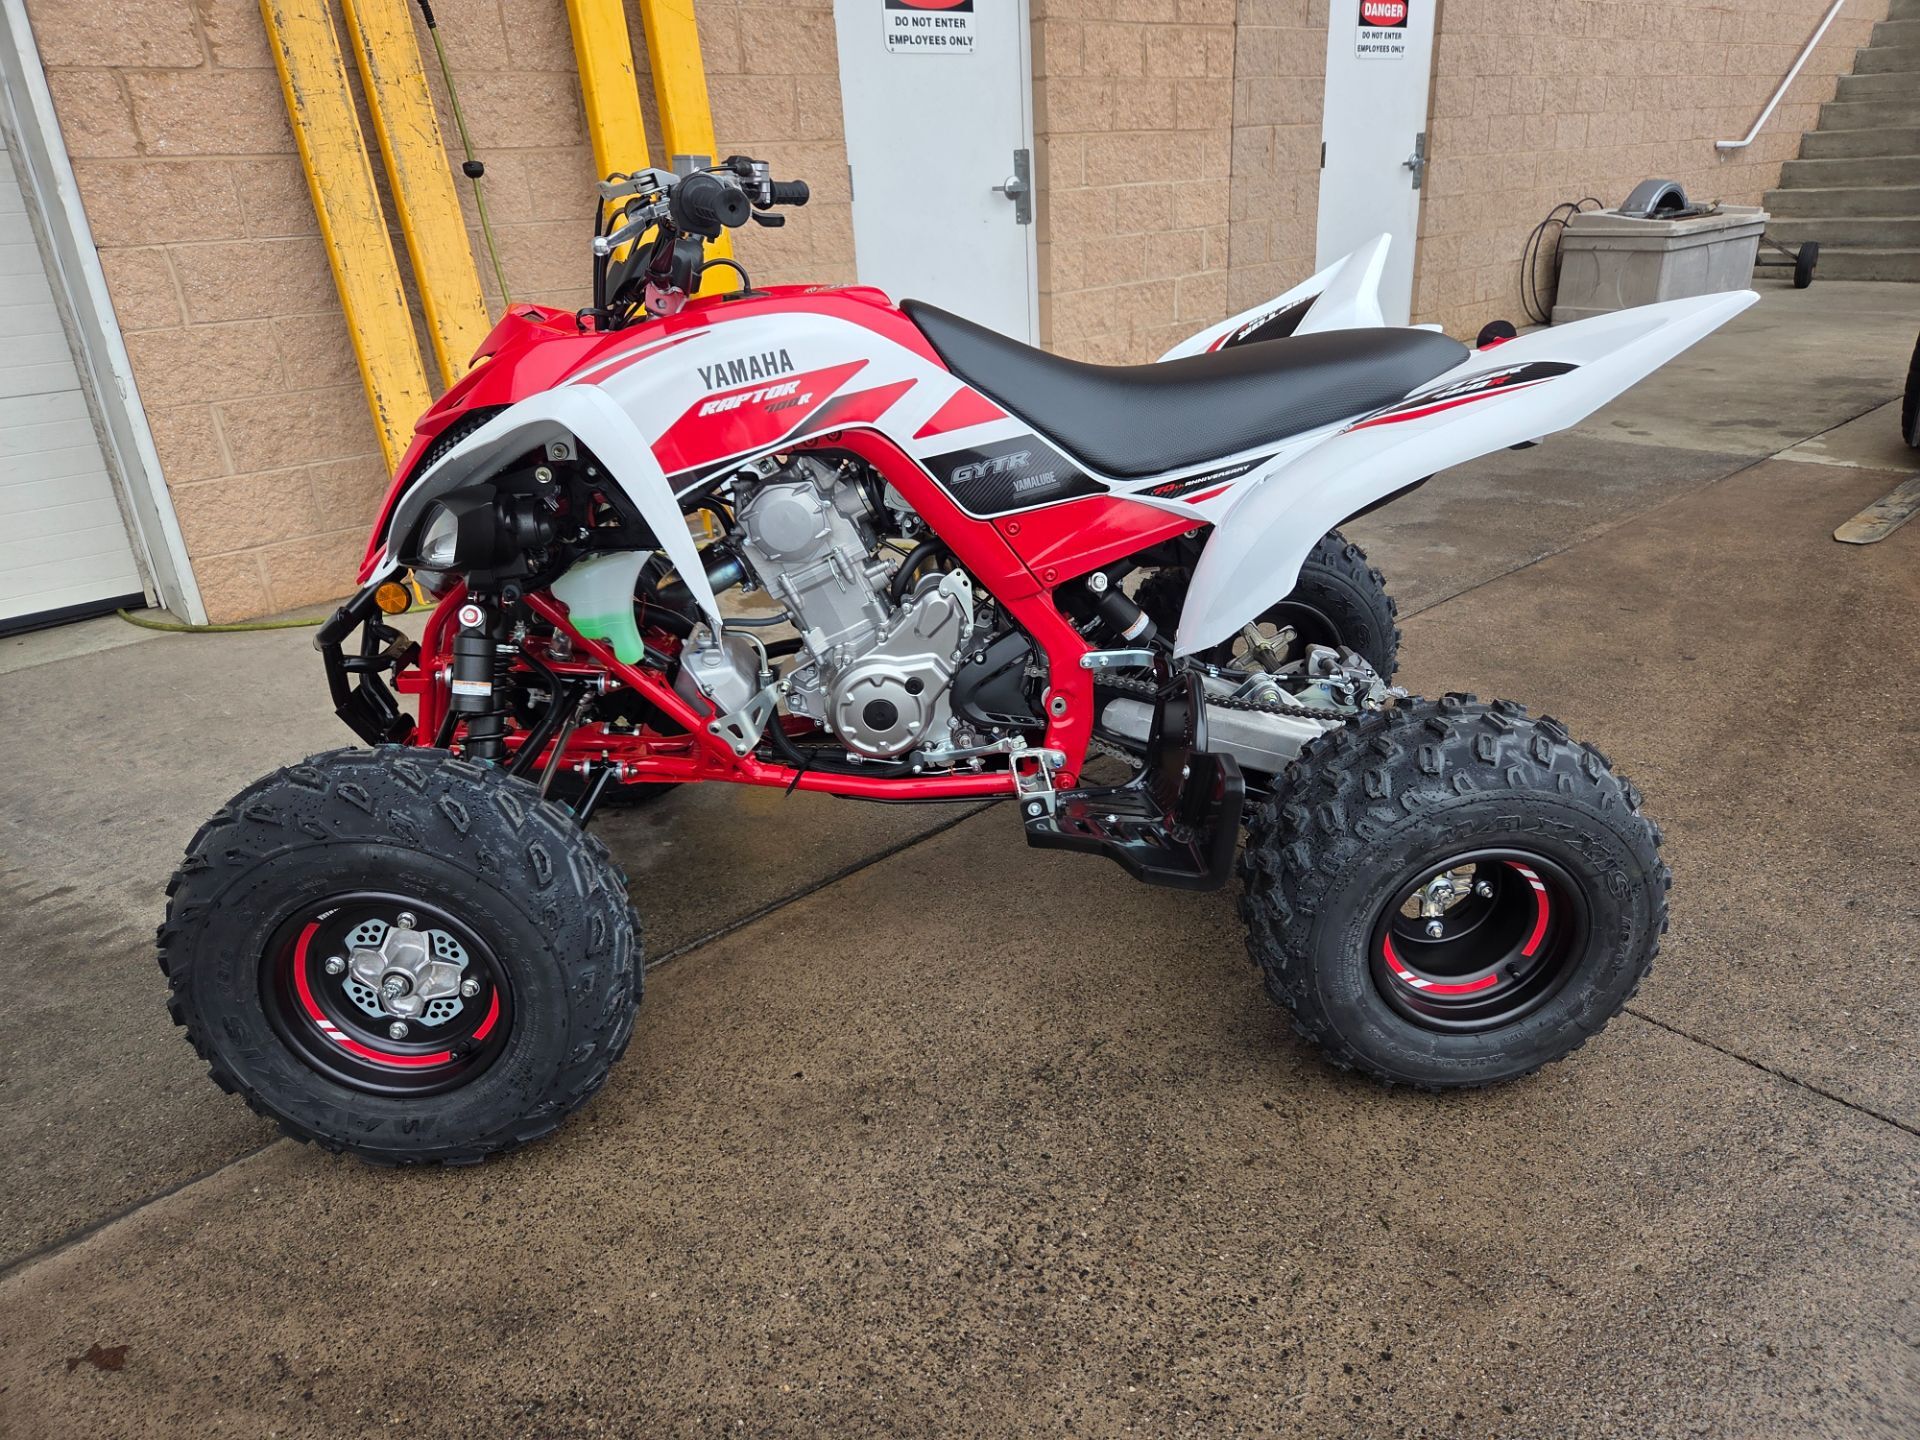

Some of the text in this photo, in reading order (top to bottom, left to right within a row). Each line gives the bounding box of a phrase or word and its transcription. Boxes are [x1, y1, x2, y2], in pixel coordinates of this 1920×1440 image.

[1364, 2, 1404, 18] DANGER
[895, 16, 966, 28] DO NOT ENTER
[889, 34, 974, 46] EMPLOYEES ONLY
[1362, 31, 1371, 39] DO
[1384, 32, 1402, 40] ENTER
[1357, 44, 1405, 54] EMPLOYEES ONLY
[697, 348, 795, 390] YAMAHA
[698, 380, 801, 417] RAPTOR
[765, 392, 813, 413] 700R
[950, 450, 1032, 485] GYTR
[1185, 464, 1250, 487] ANNIVERSARY
[1012, 470, 1057, 492] YAMALUBE
[1428, 814, 1633, 902] MAXXIS
